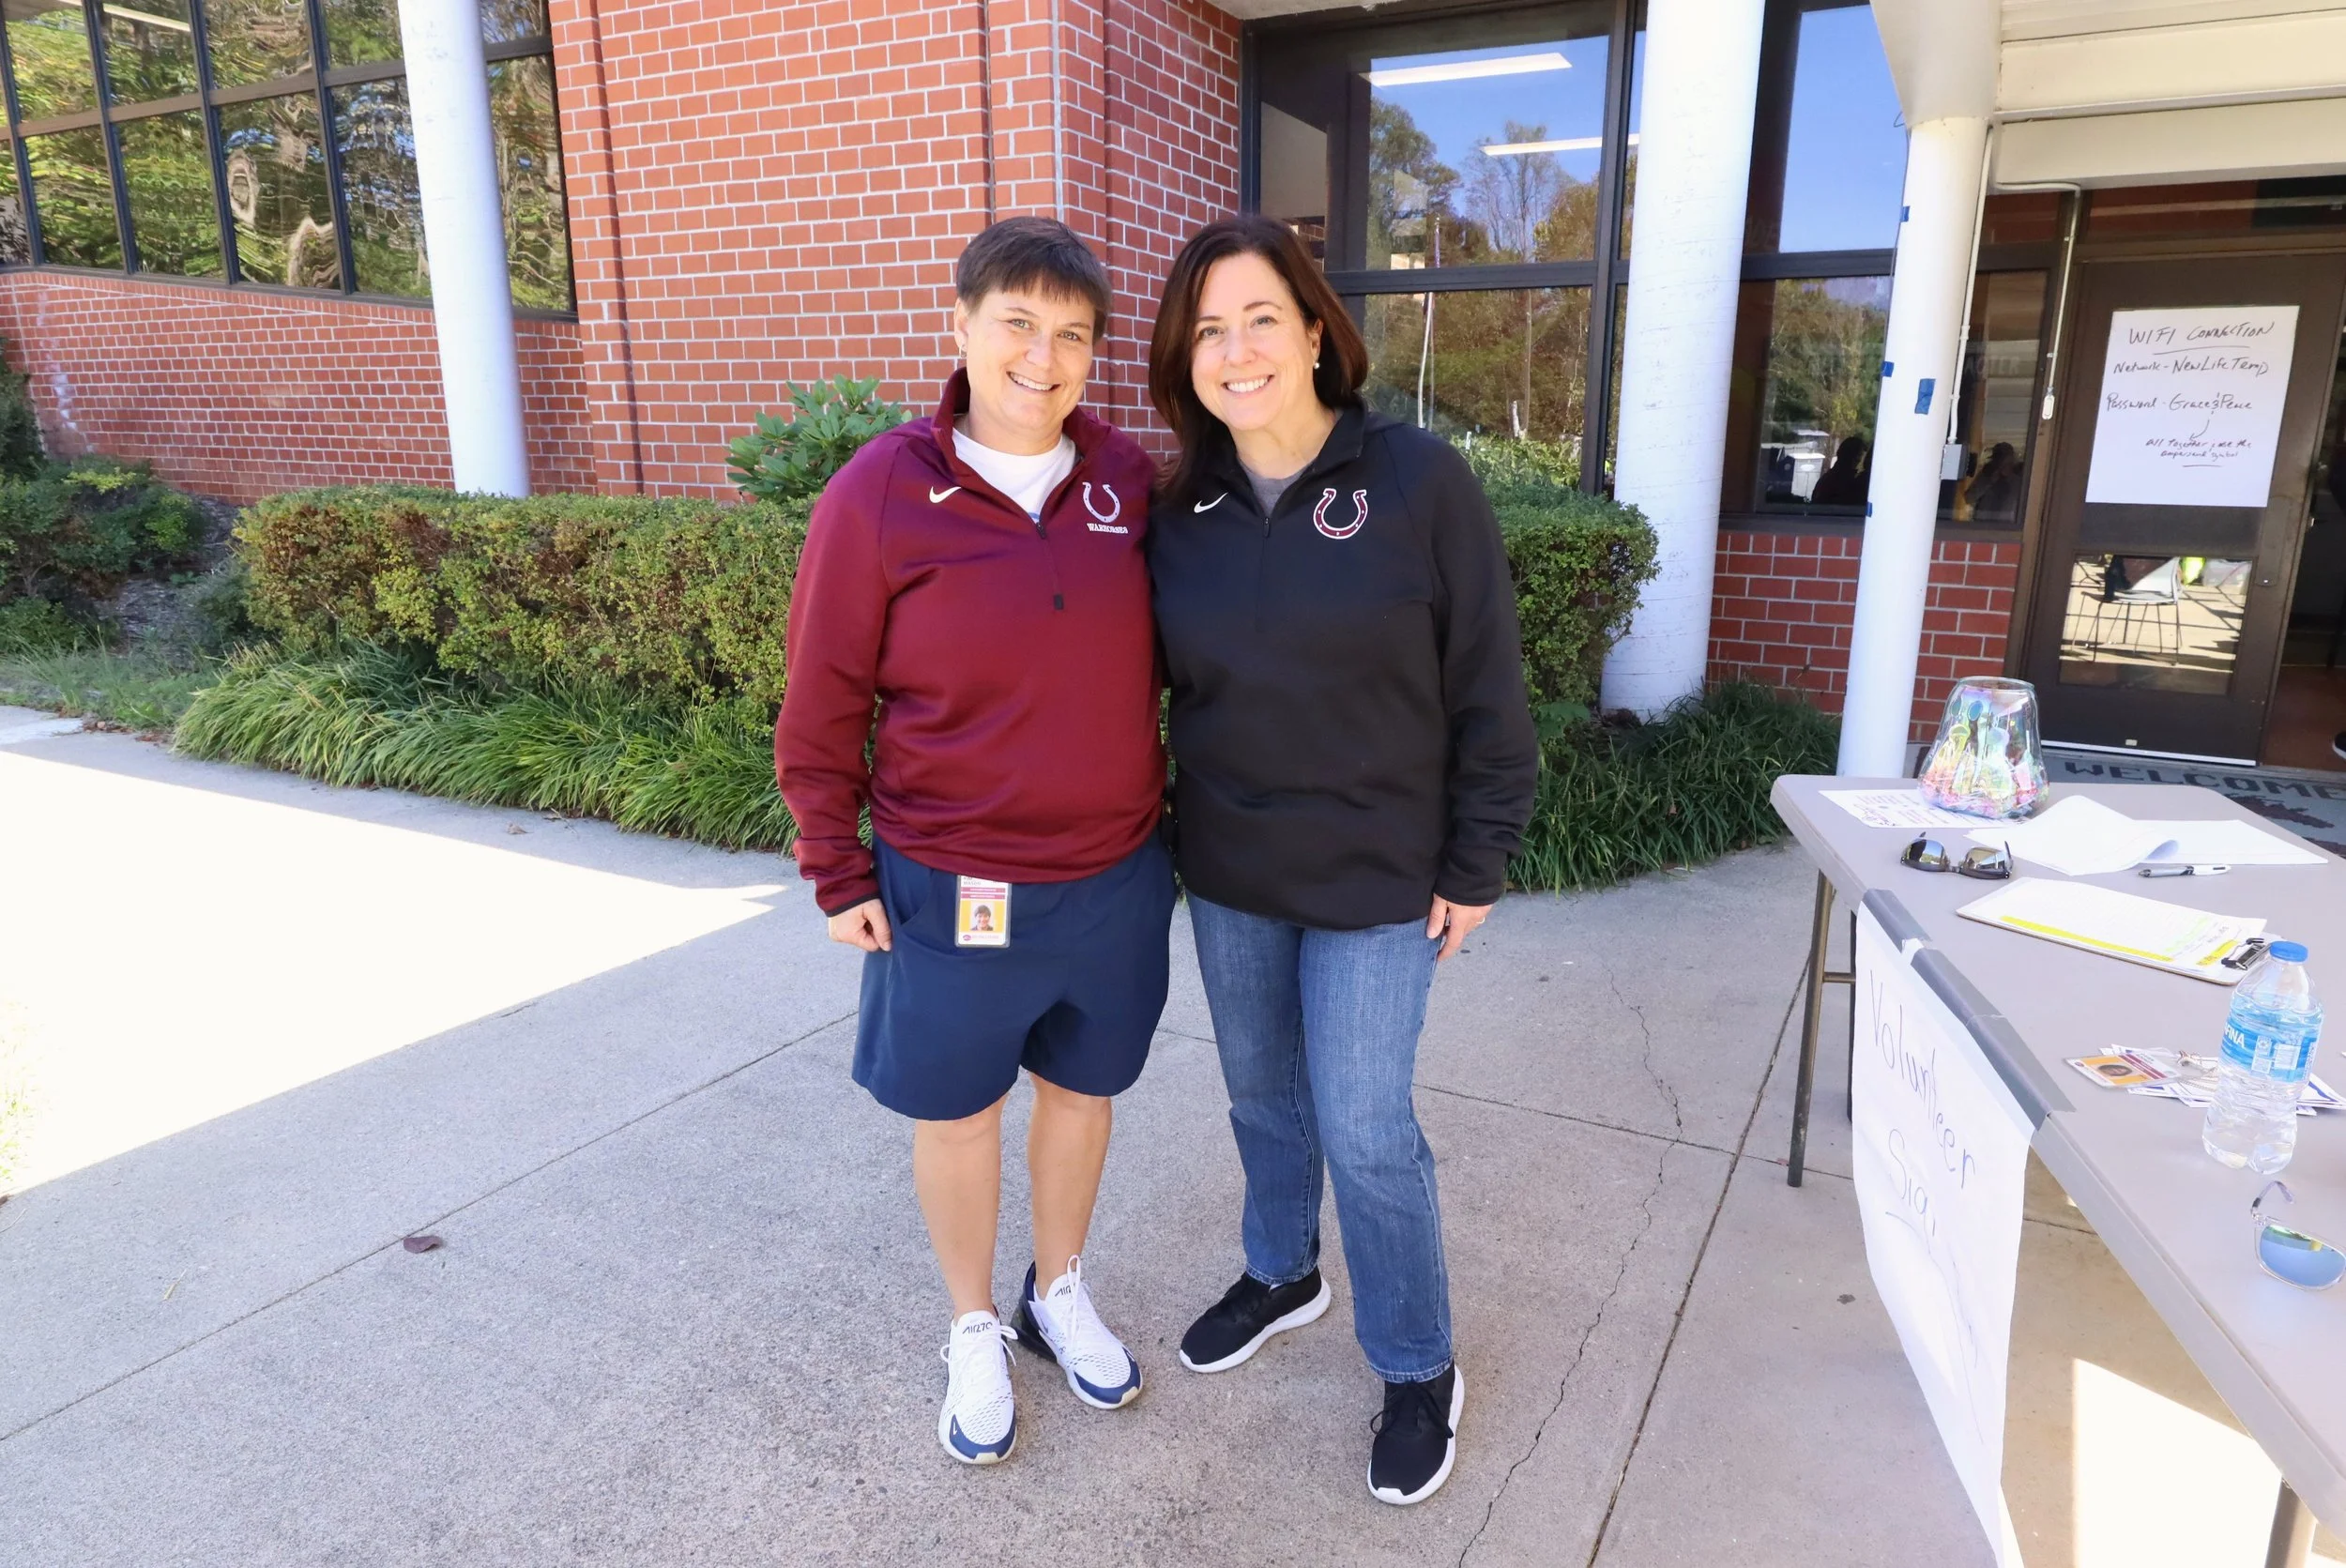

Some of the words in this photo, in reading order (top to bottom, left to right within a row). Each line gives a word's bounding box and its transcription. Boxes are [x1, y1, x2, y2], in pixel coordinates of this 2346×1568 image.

[2128, 327, 2177, 345] WIFI
[2186, 321, 2276, 343] CONNECTION
[2107, 392, 2157, 412] Password
[2064, 761, 2346, 800] WELCOME
[1869, 968, 1975, 1190] Volunteer
